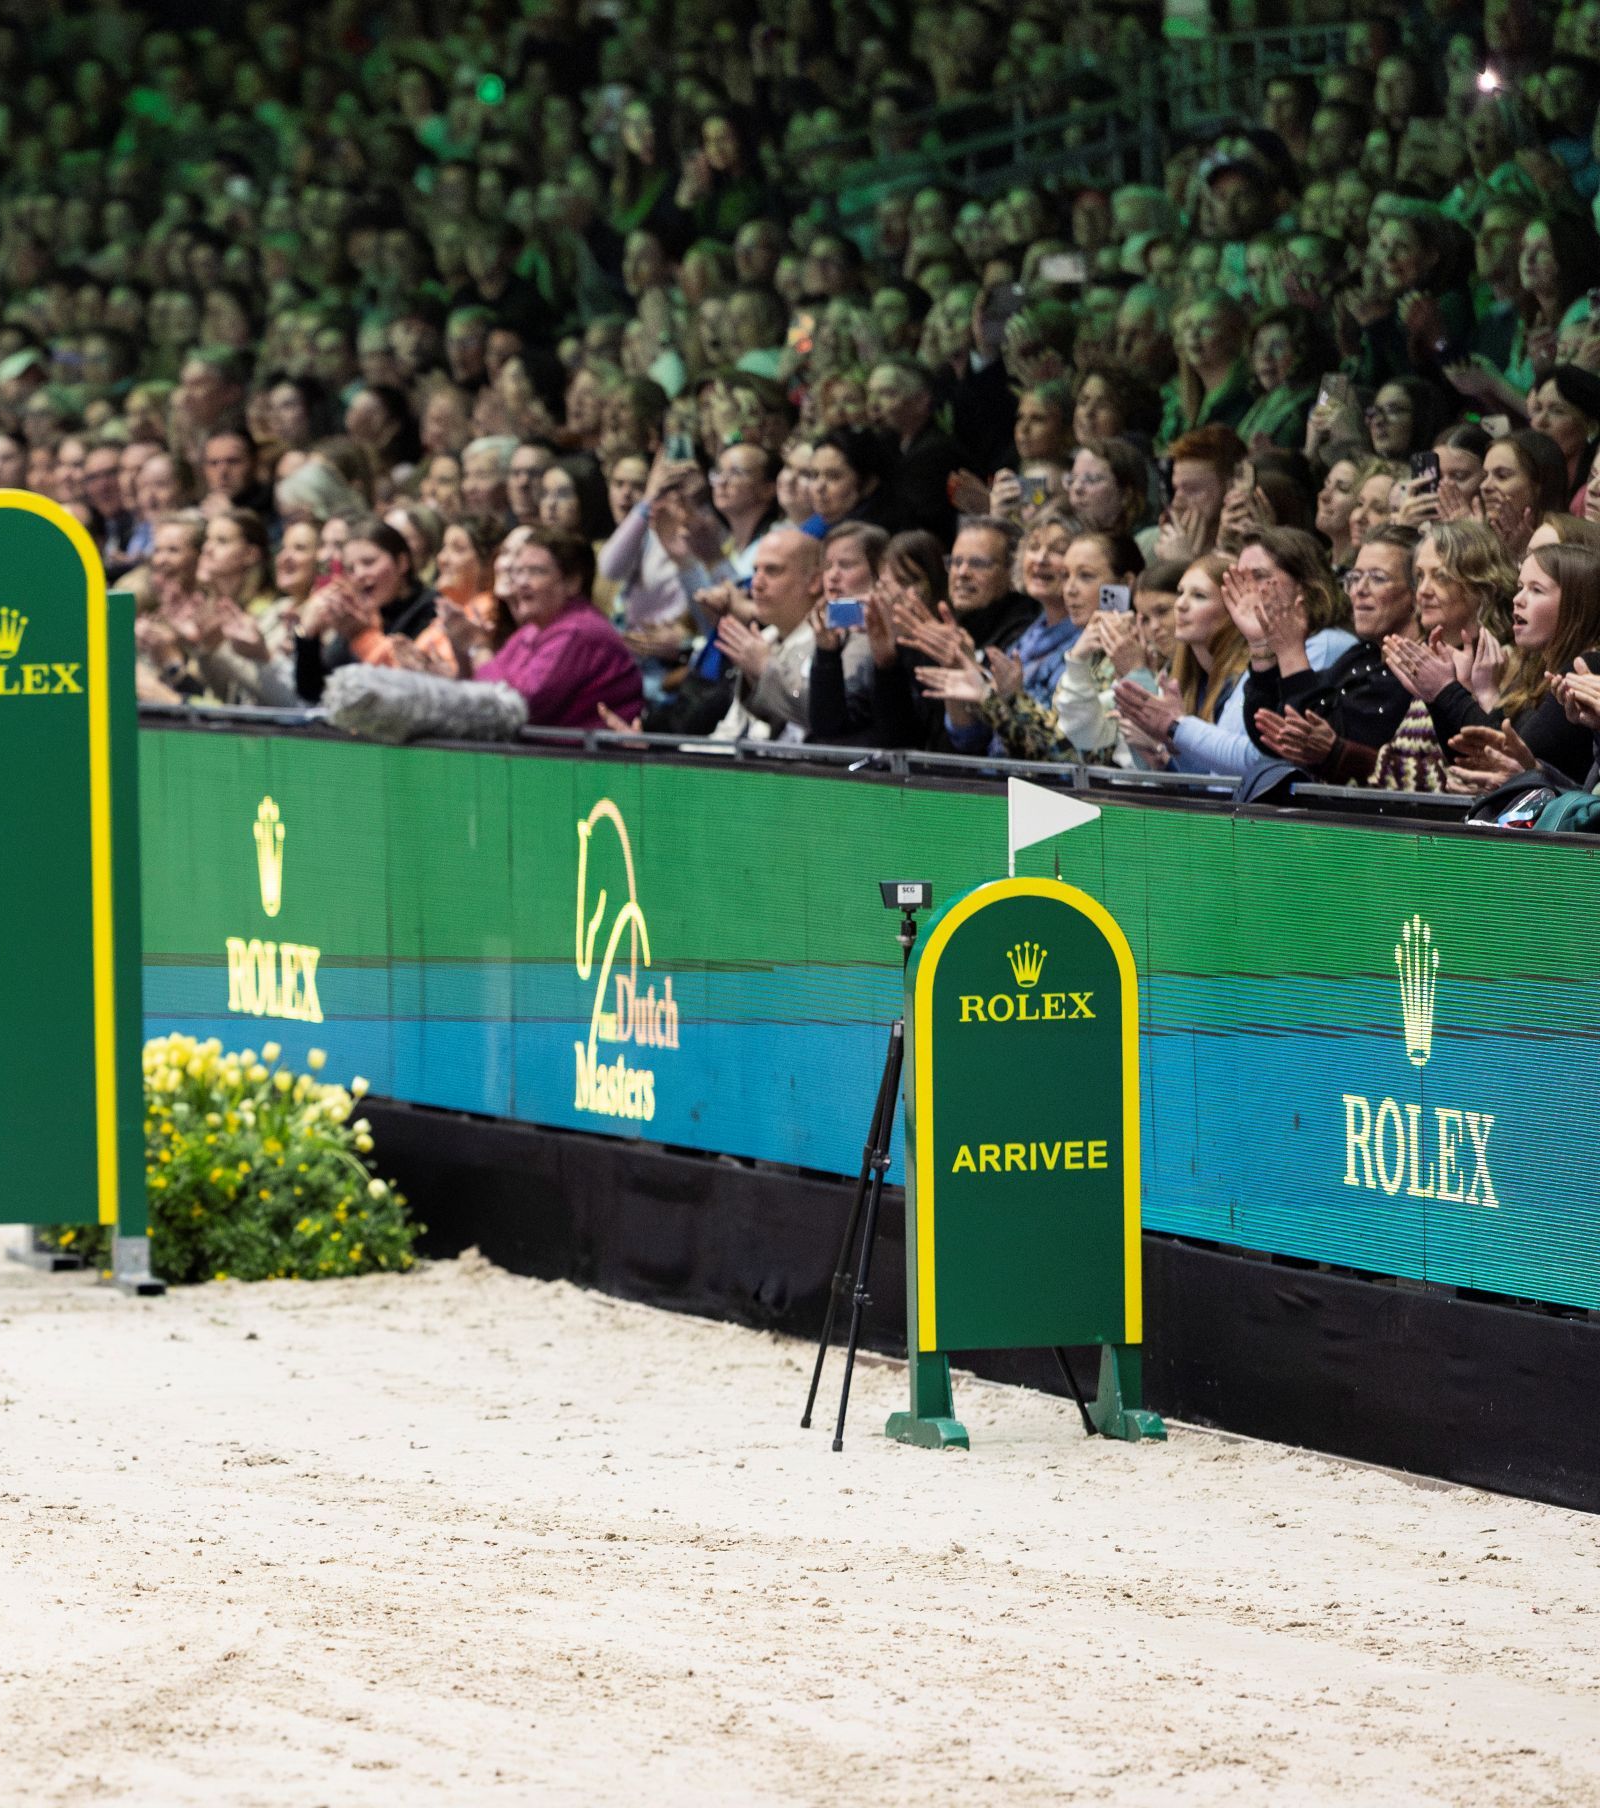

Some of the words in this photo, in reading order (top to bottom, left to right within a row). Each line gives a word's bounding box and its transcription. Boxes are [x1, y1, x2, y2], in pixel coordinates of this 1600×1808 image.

[226, 936, 324, 1024] ROLEX
[616, 974, 680, 1049] Dutch
[958, 991, 1097, 1023] ROLEX
[574, 1041, 656, 1121] Masters
[951, 1140, 1108, 1173] ARRIVEE
[1342, 1093, 1500, 1208] ROLEX
